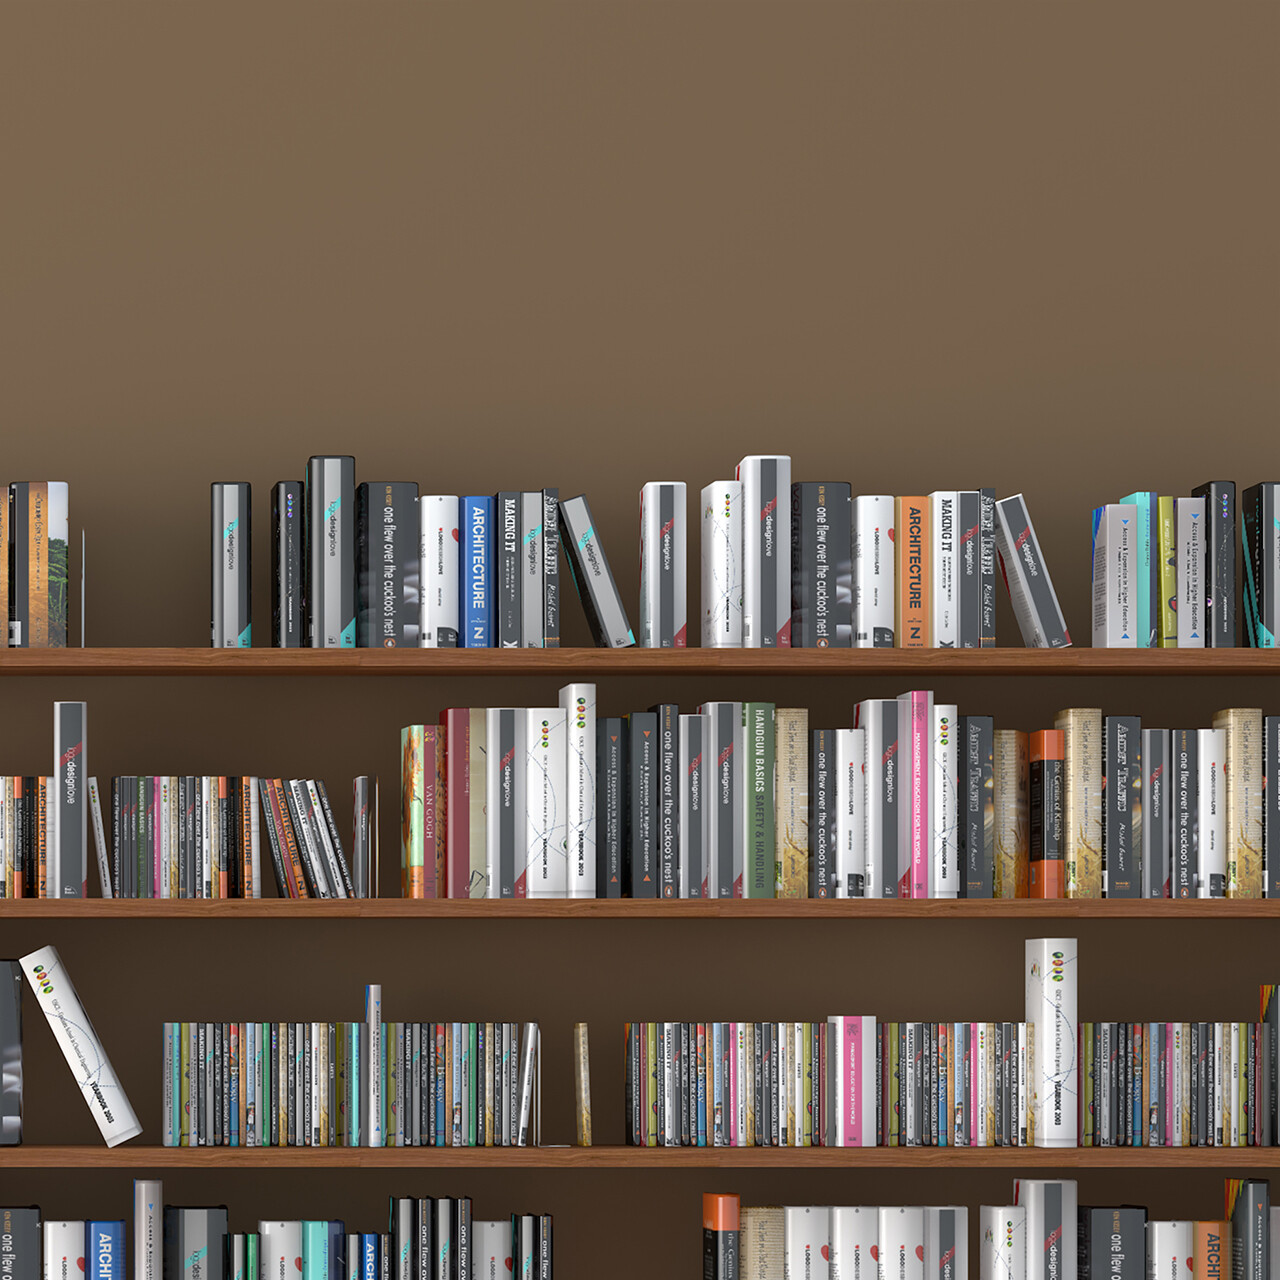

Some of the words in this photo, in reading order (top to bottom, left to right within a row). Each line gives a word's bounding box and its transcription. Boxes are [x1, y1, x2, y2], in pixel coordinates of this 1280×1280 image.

[505, 499, 515, 540] MAKING
[817, 507, 825, 525] one
[942, 499, 952, 539] MAKING
[817, 525, 829, 541] flew
[505, 542, 515, 552] IT
[817, 544, 825, 563] over
[942, 542, 952, 552] IT
[473, 507, 484, 608] ARCHITECTURE
[909, 507, 921, 608] ARCHITECTURE
[817, 565, 829, 578] the
[817, 619, 828, 636] nest
[755, 709, 764, 756] HANDGUN
[664, 752, 673, 772] flew
[755, 758, 764, 792] BASICS
[1180, 771, 1189, 788] flew
[664, 799, 673, 815] the
[755, 795, 764, 828] SAFETY
[1180, 812, 1189, 826] the
[664, 862, 672, 882] nest
[755, 841, 764, 889] HANDLING
[1180, 868, 1188, 885] nest
[1111, 1234, 1120, 1254] one
[1111, 1254, 1124, 1272] flew
